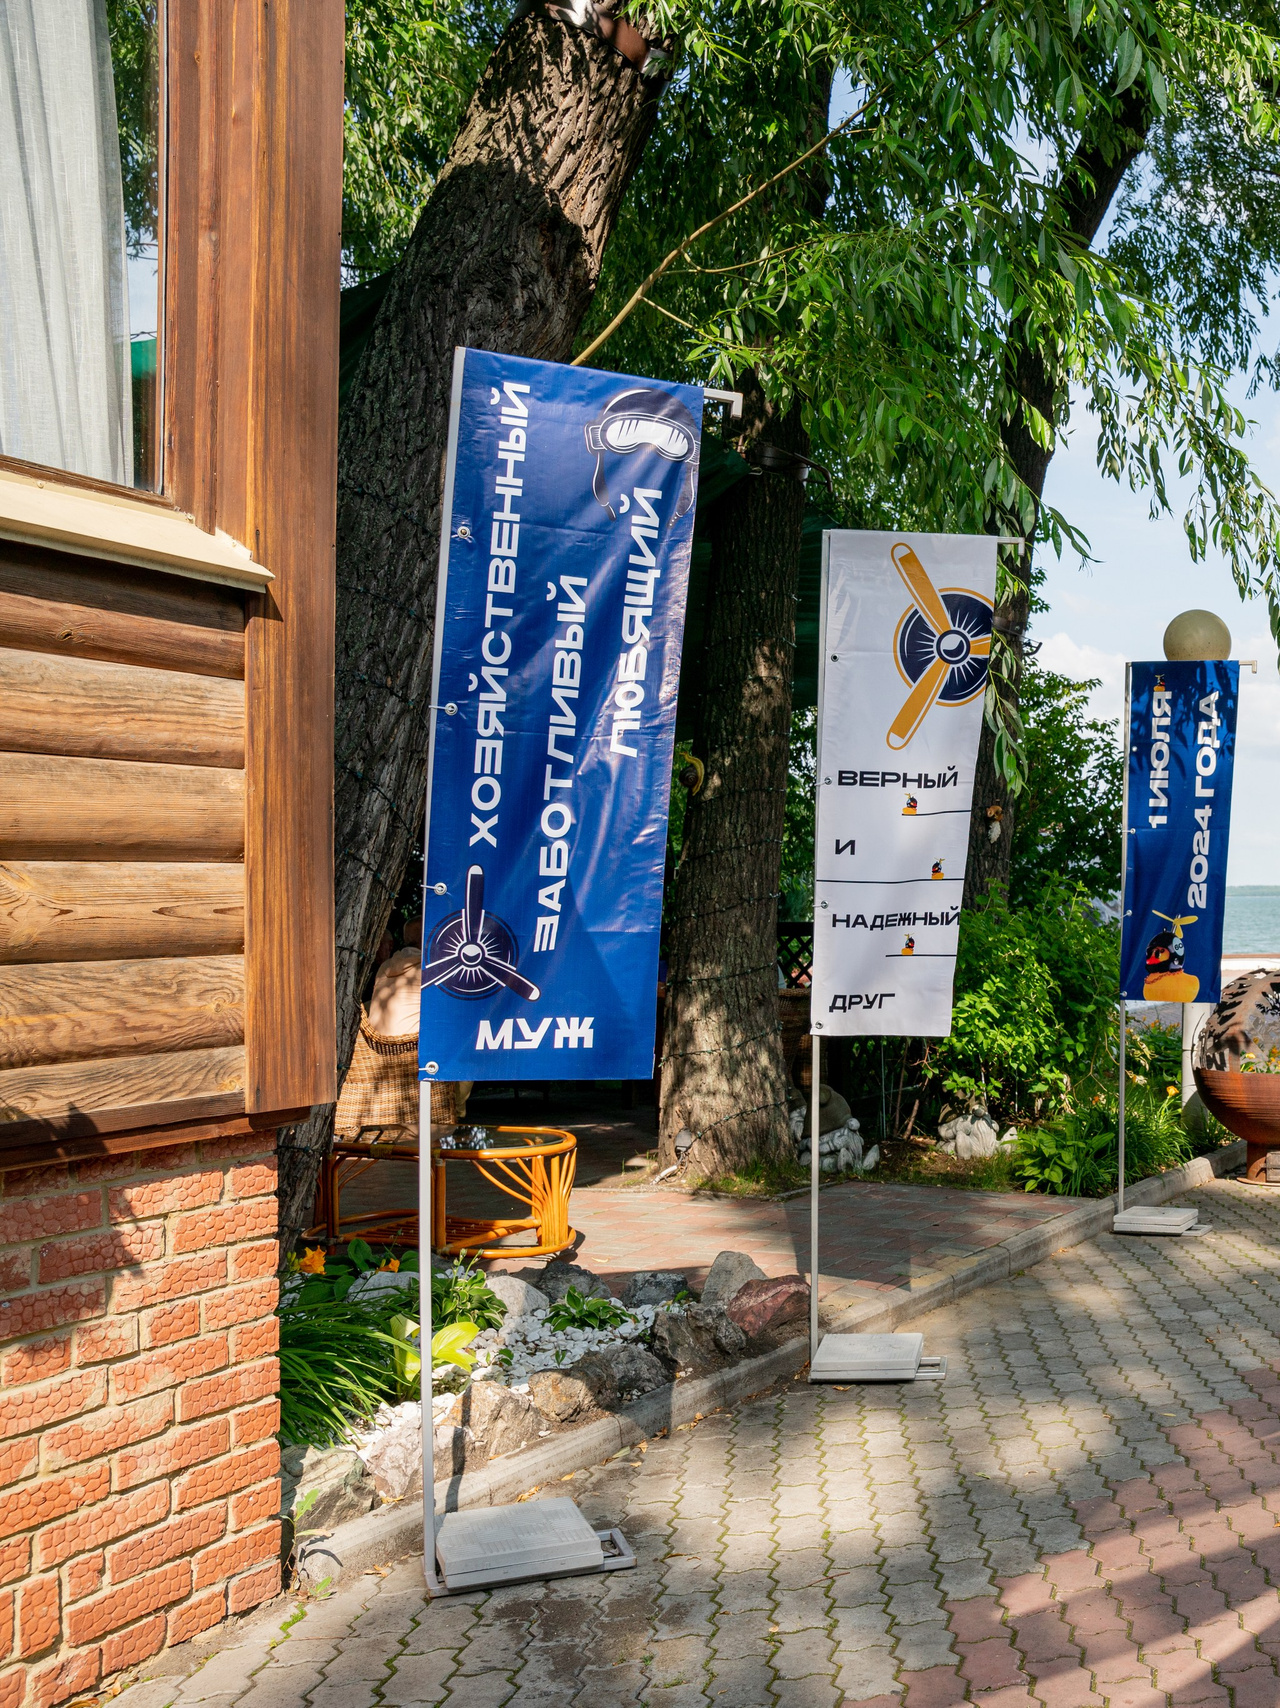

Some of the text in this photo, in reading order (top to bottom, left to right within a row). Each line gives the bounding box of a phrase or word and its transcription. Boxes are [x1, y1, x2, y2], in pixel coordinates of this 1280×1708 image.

[468, 382, 530, 848] ХОЗЯЙСТВЕННЫЙ
[609, 487, 662, 758] ЛЮБЯЩИЙ
[533, 575, 588, 952] ЗАБОТЛИВЫЙ
[837, 765, 959, 789] ВЕРНЫЙ
[1149, 691, 1172, 829] 1 ИЮЛЯ
[1187, 690, 1221, 909] 2024 ГОДА
[835, 839, 856, 855] И
[831, 906, 961, 930] НАДЕЖНЫЙ
[475, 1016, 595, 1050] МУЖ
[828, 993, 896, 1013] ДРУГ
